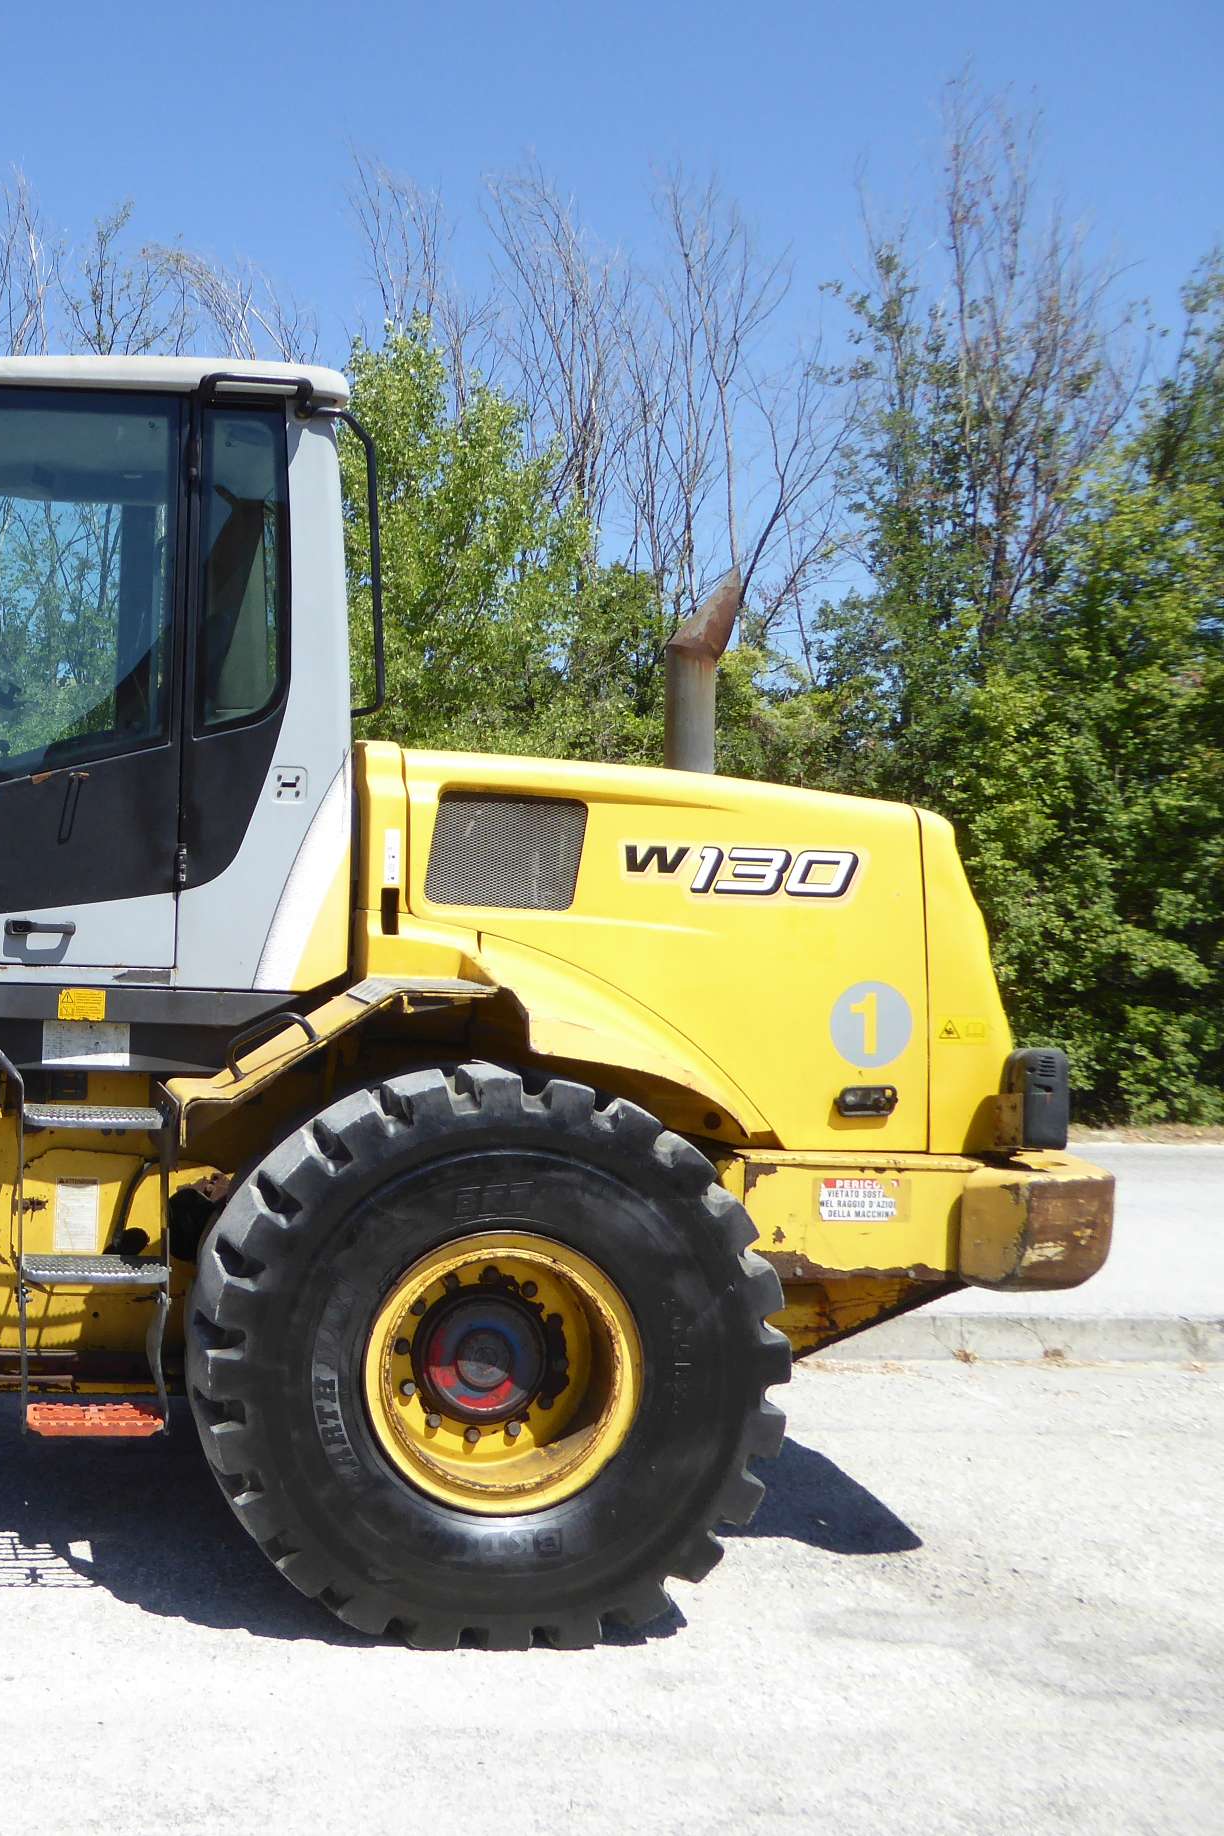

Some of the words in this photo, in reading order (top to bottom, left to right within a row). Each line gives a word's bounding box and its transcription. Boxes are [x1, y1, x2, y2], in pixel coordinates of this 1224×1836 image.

[849, 992, 878, 1055] 1
[836, 1180, 899, 1188] PERICO
[827, 1190, 859, 1198] VIETATO
[863, 1190, 886, 1198] SOST
[838, 1200, 865, 1208] RAGGIO
[828, 1210, 851, 1218] DELLA
